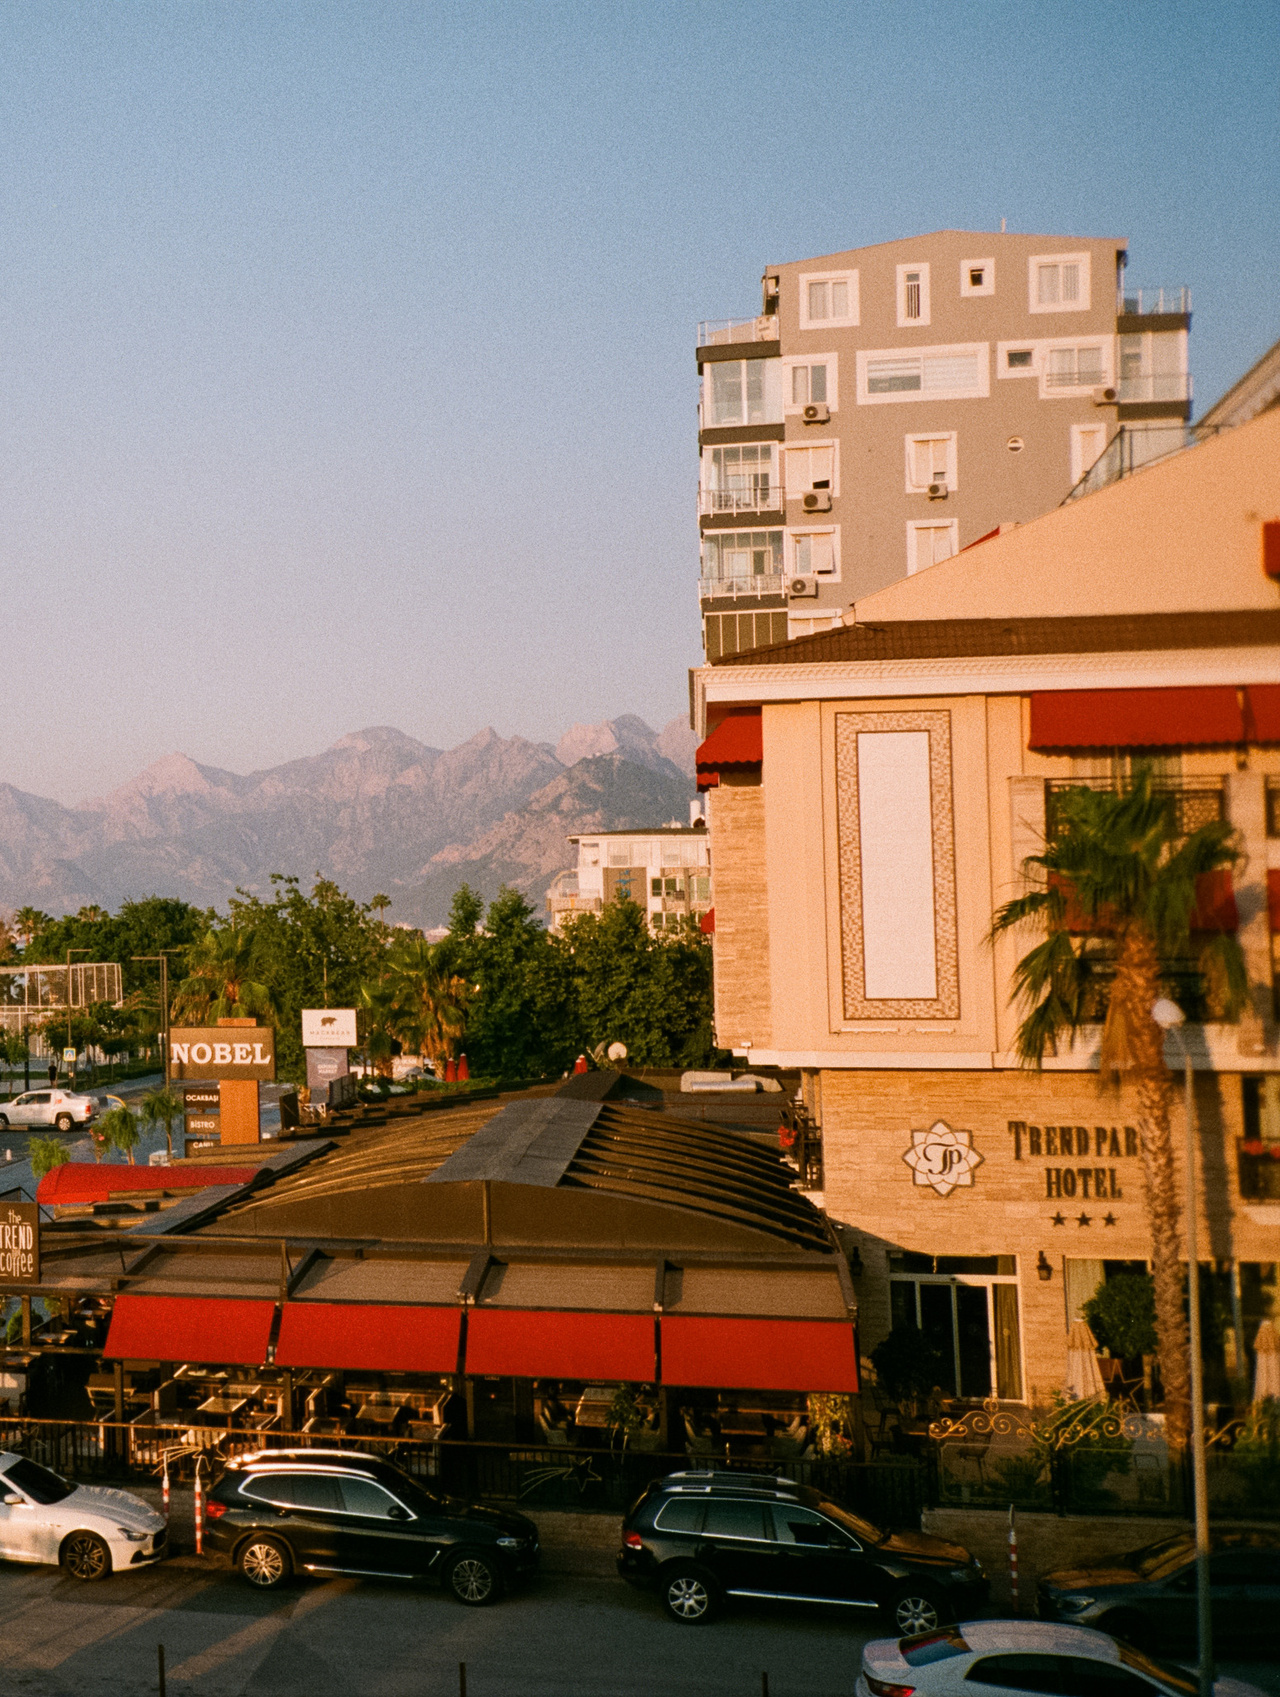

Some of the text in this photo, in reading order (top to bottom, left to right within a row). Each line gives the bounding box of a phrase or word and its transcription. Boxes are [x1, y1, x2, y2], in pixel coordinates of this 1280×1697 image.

[170, 1043, 271, 1064] NOBEL
[185, 1094, 219, 1102] OCAKBAŞI
[1094, 1126, 1138, 1157] PAR
[1045, 1167, 1122, 1199] HOTEL
[8, 1209, 21, 1224] the
